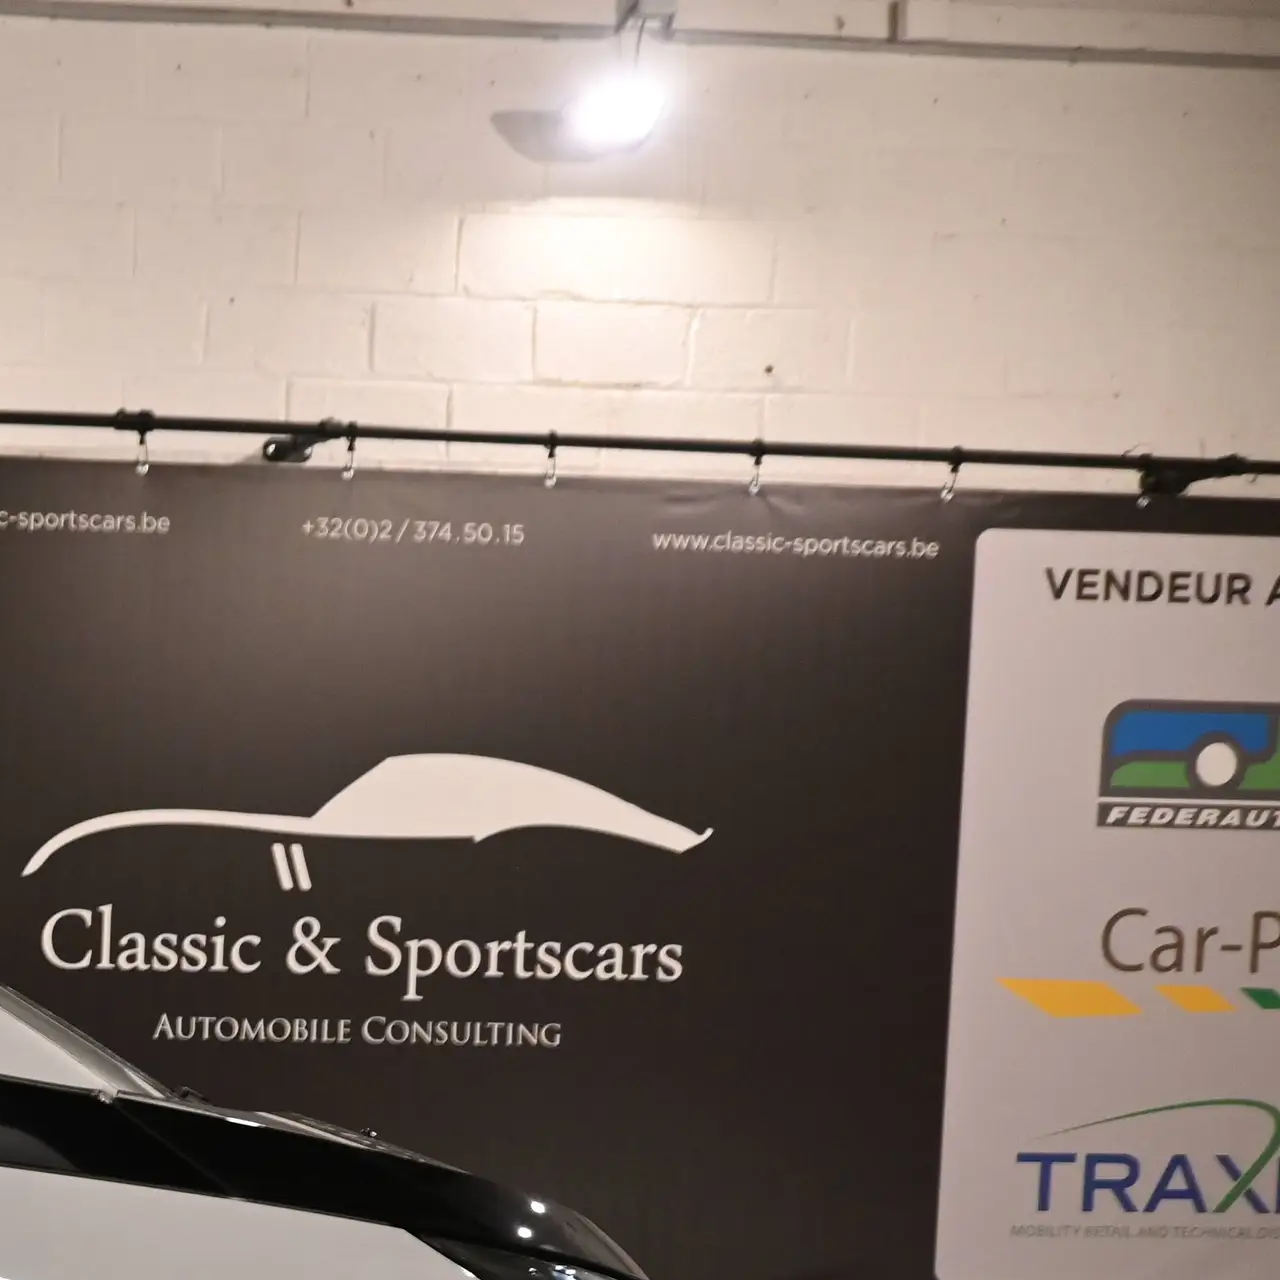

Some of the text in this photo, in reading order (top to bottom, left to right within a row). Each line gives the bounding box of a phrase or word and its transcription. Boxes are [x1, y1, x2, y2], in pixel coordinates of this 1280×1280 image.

[651, 529, 940, 559] www.classic-sportscars.be
[1045, 567, 1253, 606] VENDEUR
[40, 902, 684, 1001] Classic & Sportscars
[1101, 906, 1280, 974] Car-P
[152, 1011, 563, 1048] AUTOMOBILE CONSULTING
